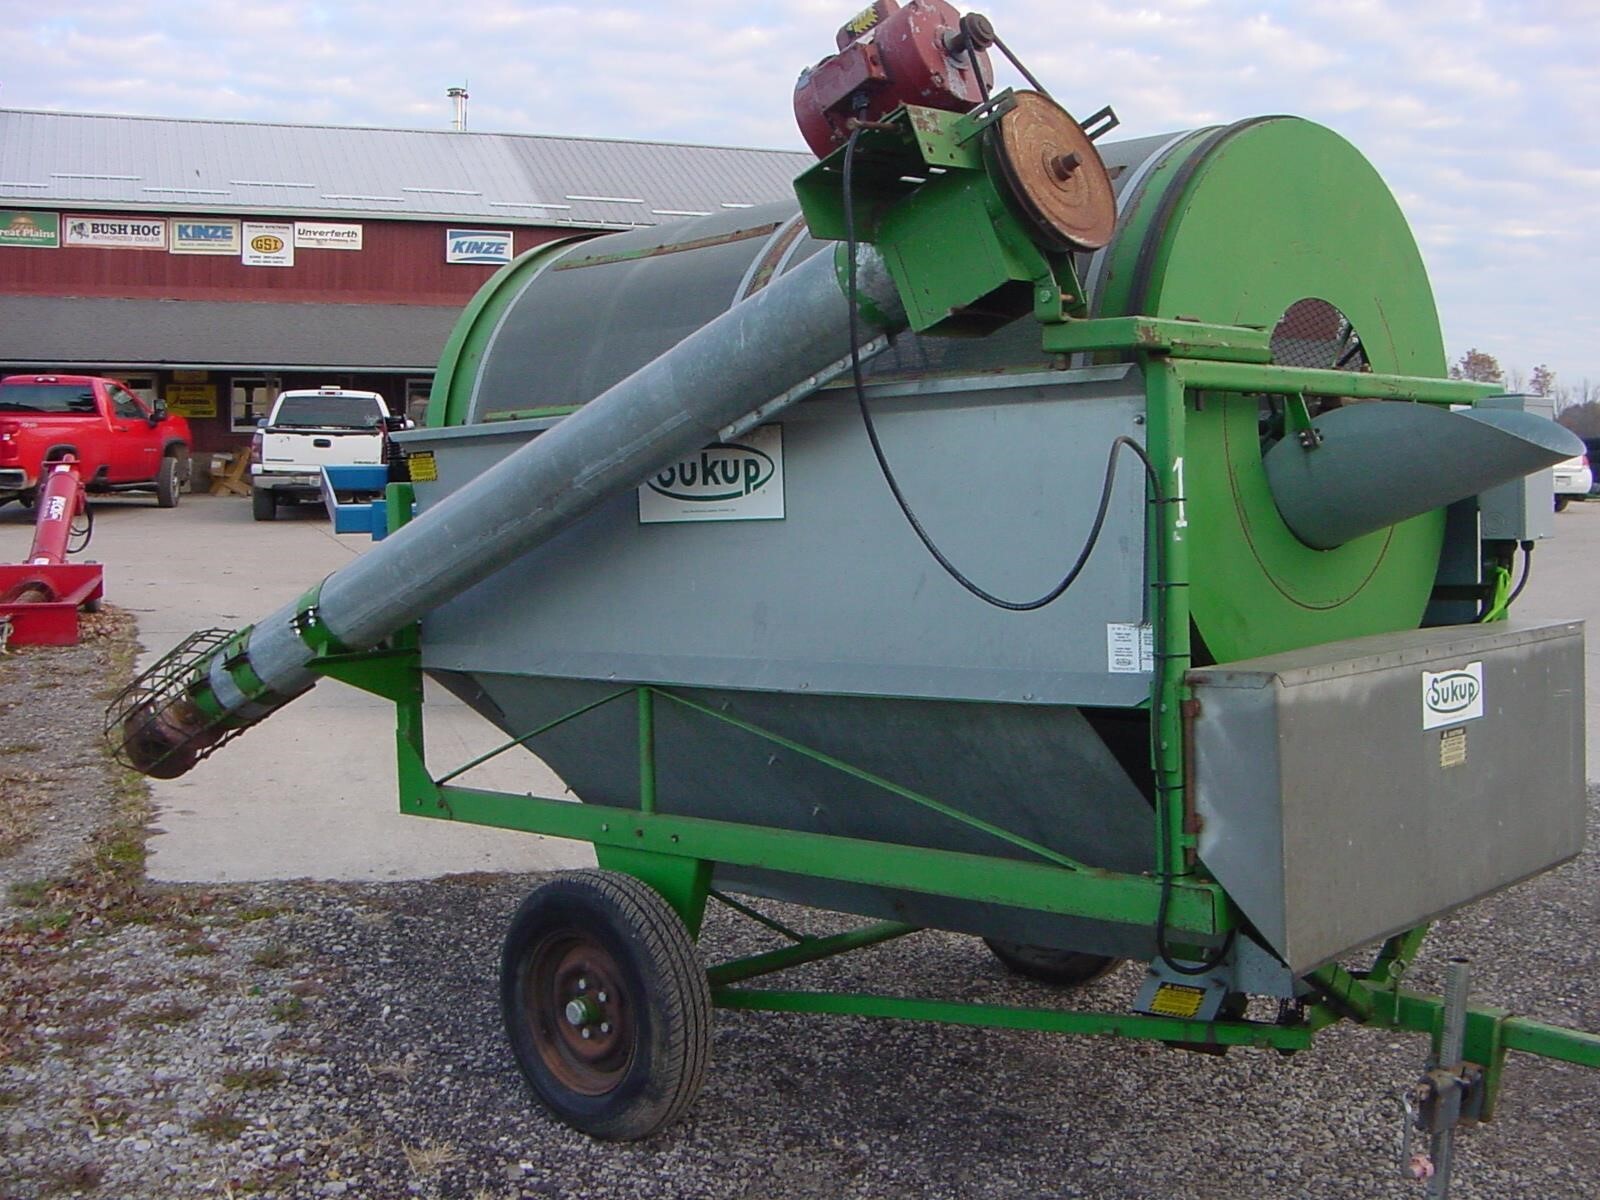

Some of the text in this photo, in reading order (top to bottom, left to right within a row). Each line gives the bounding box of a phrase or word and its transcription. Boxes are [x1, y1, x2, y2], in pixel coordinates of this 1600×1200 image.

[0, 228, 55, 238] reat Plains
[91, 223, 161, 236] BUSH HOG
[178, 225, 233, 240] KINZE
[298, 228, 358, 239] Unverferth
[255, 238, 279, 251] GSI
[451, 240, 508, 255] KINZE
[1431, 677, 1475, 706] Sukup
